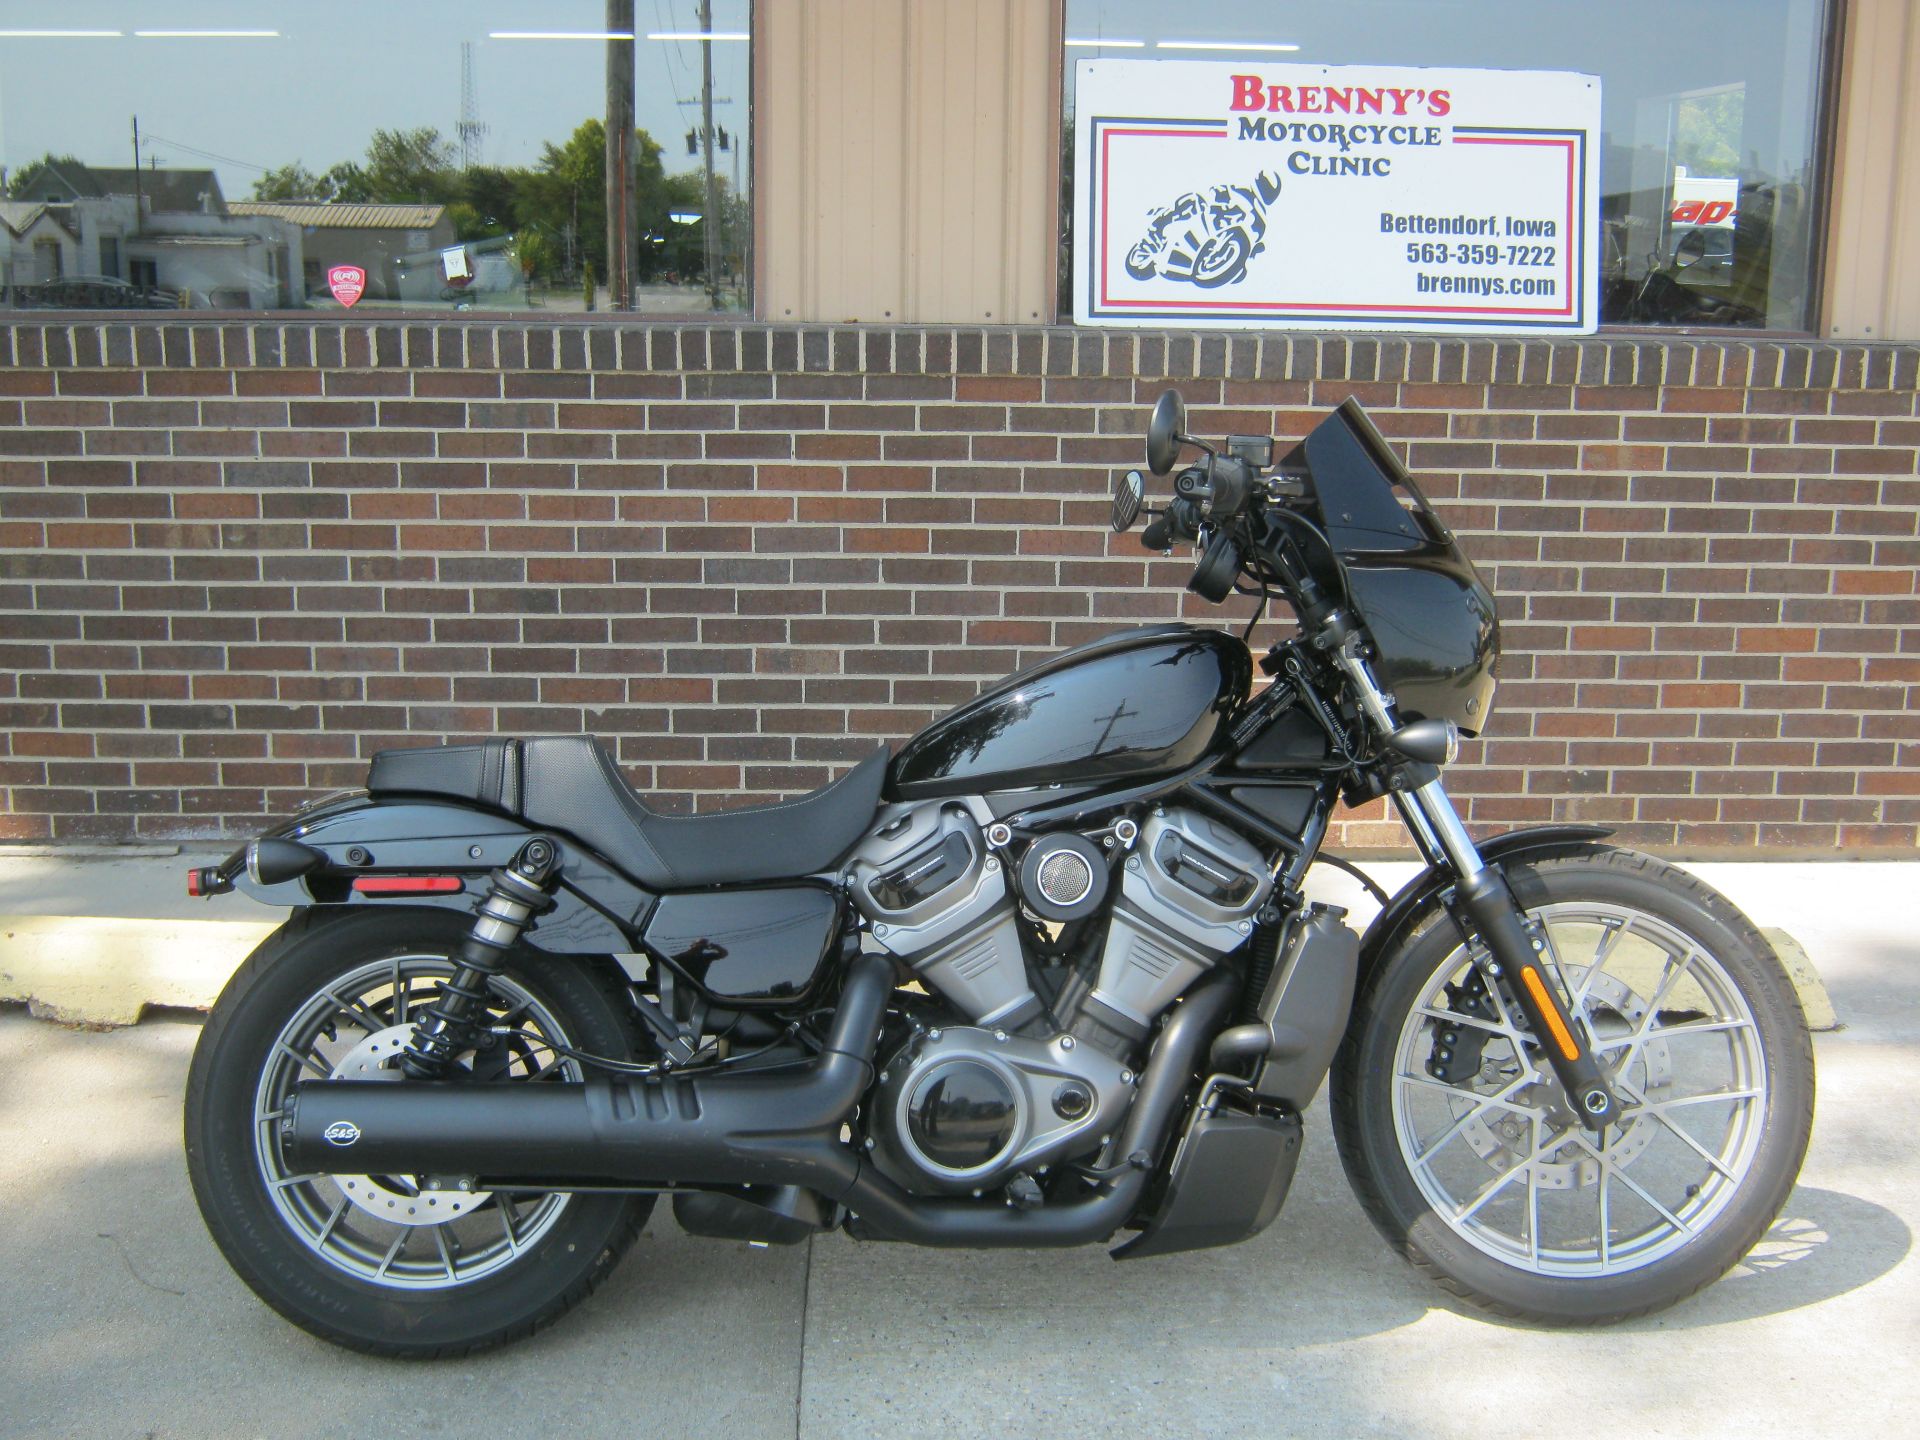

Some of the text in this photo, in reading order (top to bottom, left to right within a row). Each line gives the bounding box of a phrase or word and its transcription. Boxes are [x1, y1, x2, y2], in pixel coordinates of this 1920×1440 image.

[1229, 75, 1450, 116] BRENNY'S
[1238, 117, 1442, 151] MOTORCYCLE
[1287, 151, 1391, 177] CLINIC
[1380, 212, 1556, 238] Bettendorf, Iowa
[1672, 200, 1738, 226] ap
[1406, 244, 1556, 267] 563-359-7222
[1417, 272, 1556, 297] brennys.com
